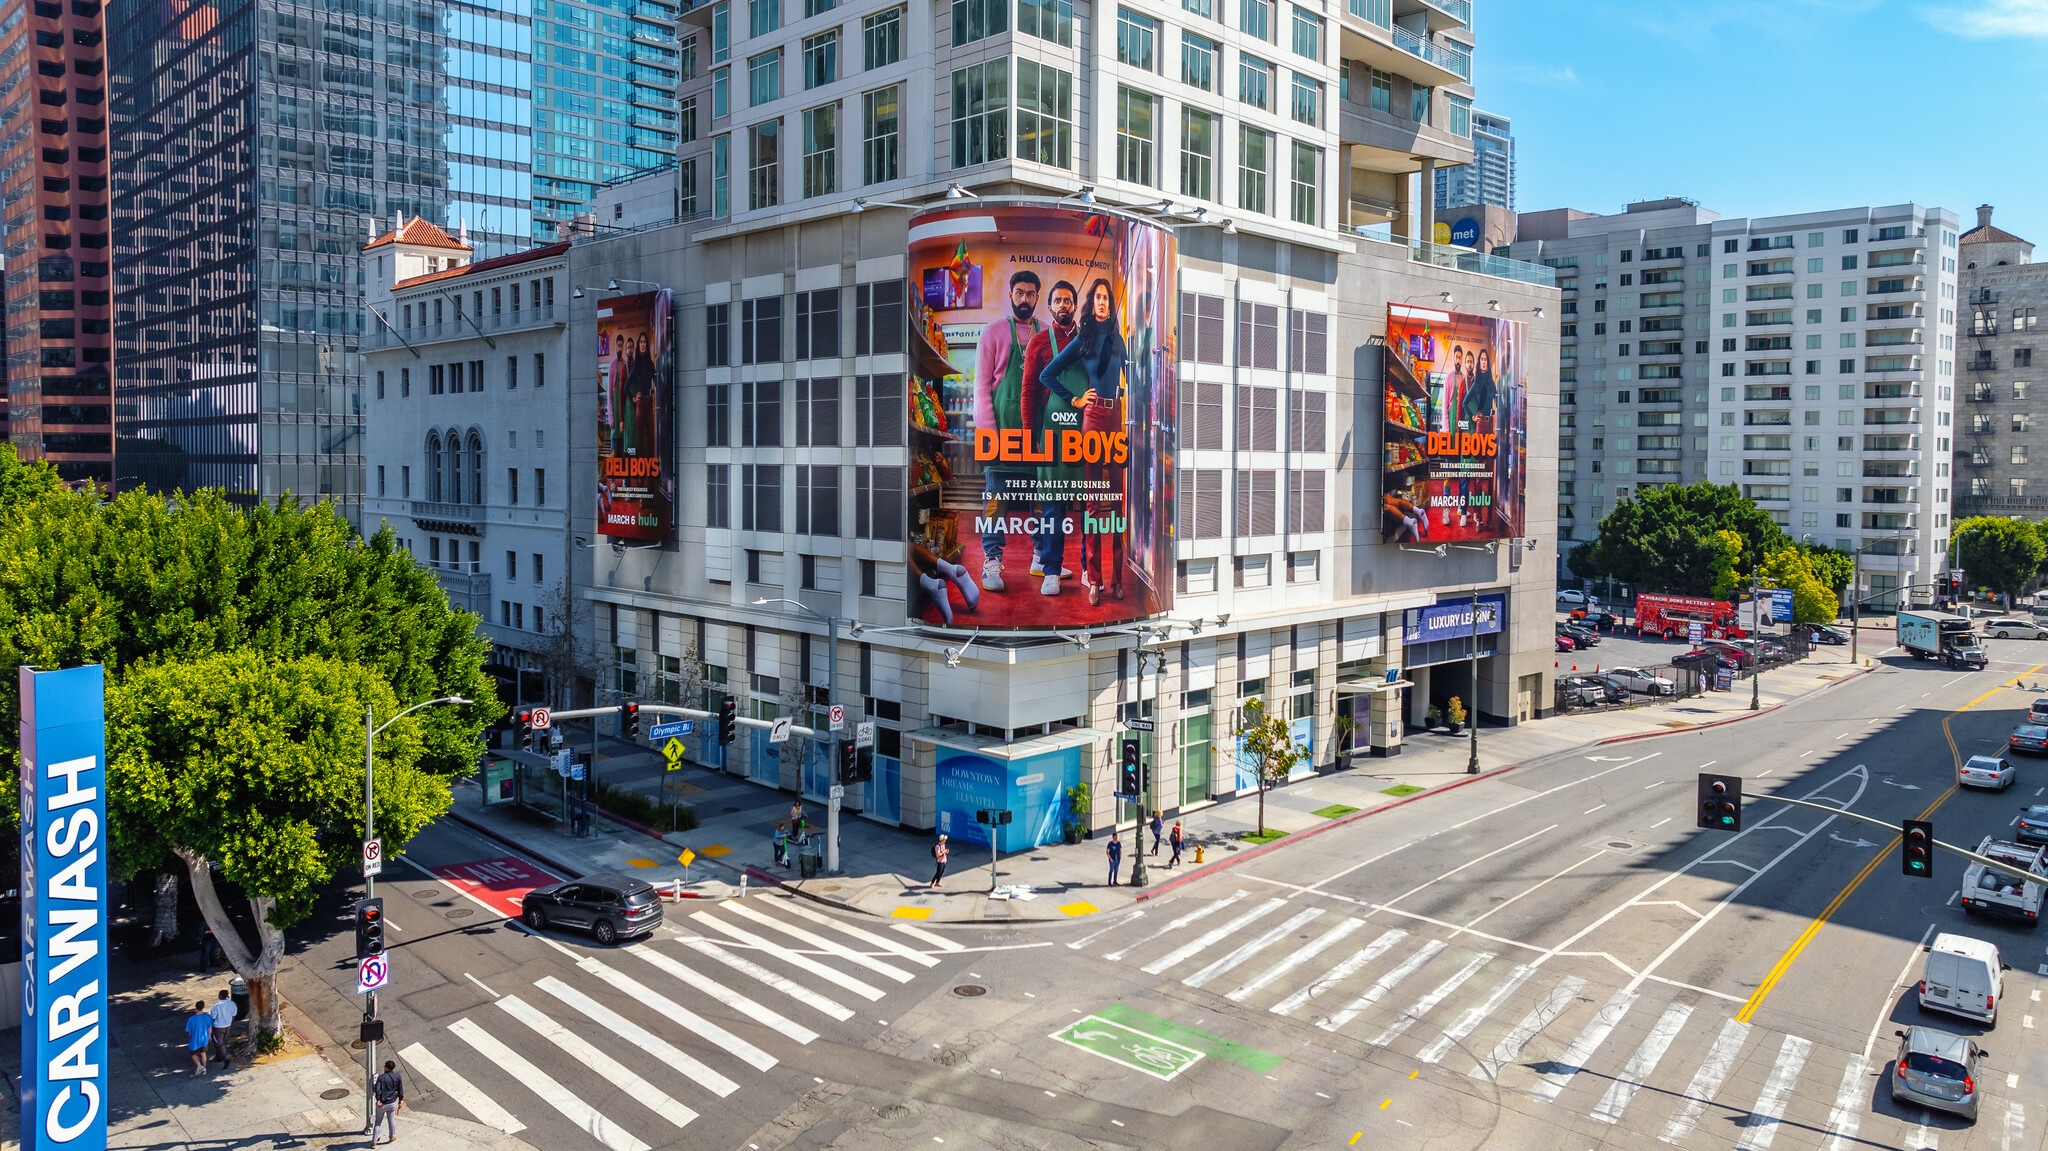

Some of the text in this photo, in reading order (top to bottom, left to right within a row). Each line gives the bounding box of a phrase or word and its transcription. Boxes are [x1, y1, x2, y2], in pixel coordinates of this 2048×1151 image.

[1453, 228, 1474, 240] met
[1009, 254, 1111, 271] A HULU ORIGINAL COMEDY
[1051, 412, 1078, 422] ONYX
[974, 428, 1128, 464] DELI BOYS
[1427, 431, 1497, 457] DELI BOYS
[605, 457, 660, 477] DELI BOYS
[1005, 479, 1111, 489] THE FAMILY BUSINESS
[981, 491, 1123, 502] IS ANYTHING BUT CONVENIENT
[1430, 491, 1491, 507] MARCH 6 hulu
[607, 512, 658, 527] MARCH 6 hulu
[974, 510, 1127, 535] MARCH 6 hulu
[1429, 613, 1460, 630] LUXURY
[653, 725, 681, 736] Olympic
[951, 767, 1000, 786] DOWNTOWN
[444, 861, 531, 886] LANE
[24, 757, 36, 1018] CAR WASH
[46, 754, 99, 1143] CAR WASH
